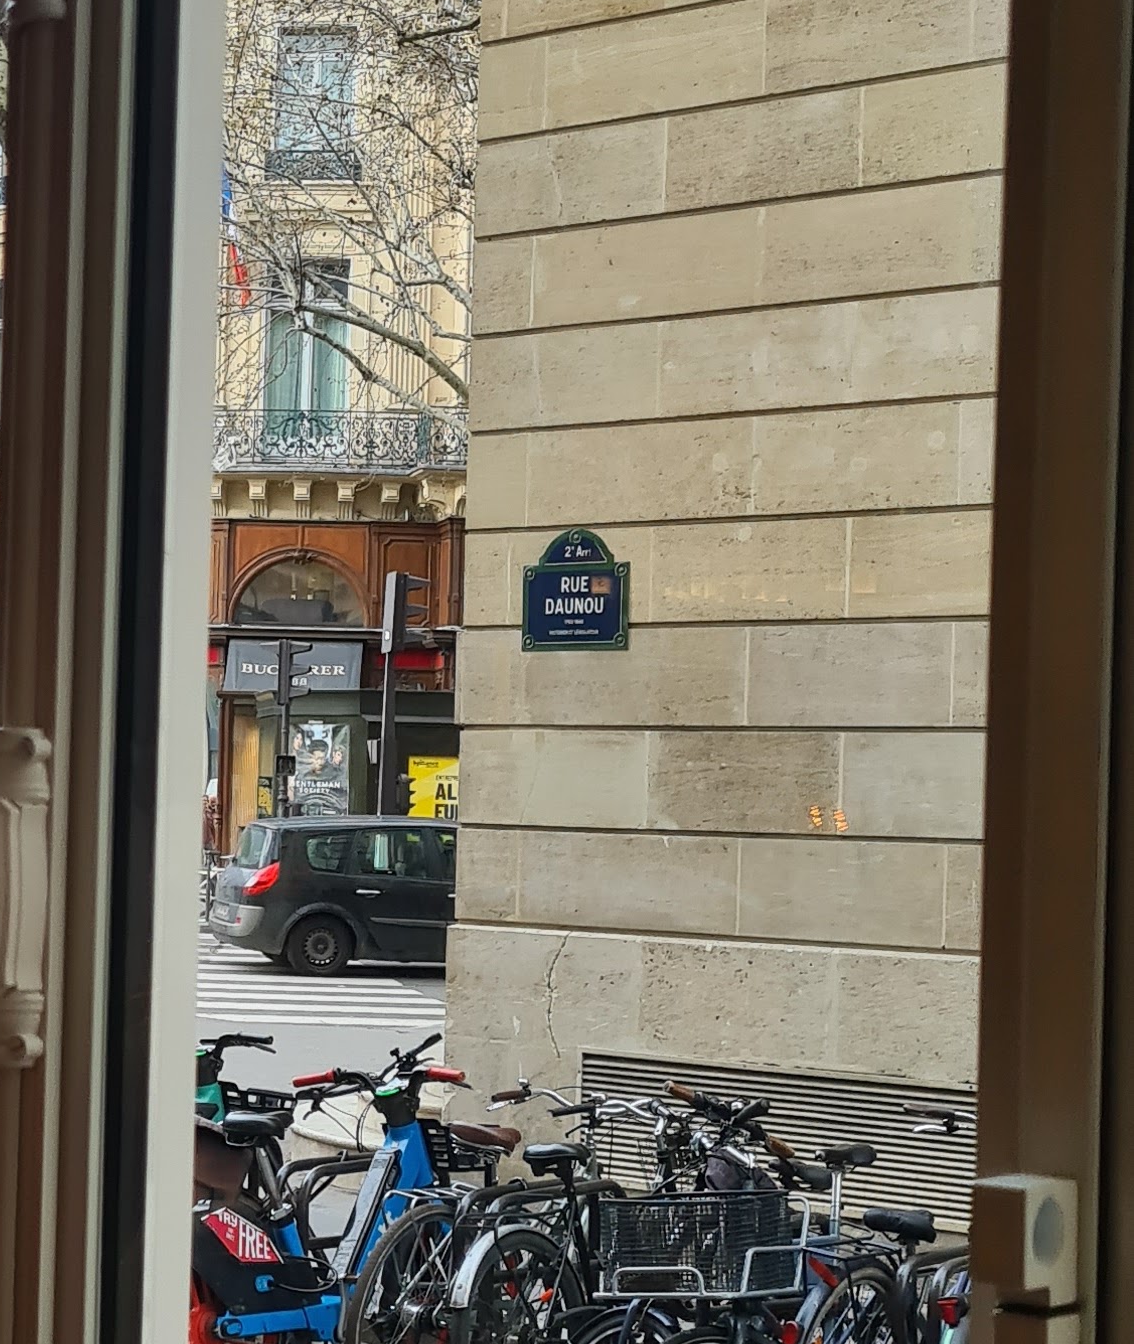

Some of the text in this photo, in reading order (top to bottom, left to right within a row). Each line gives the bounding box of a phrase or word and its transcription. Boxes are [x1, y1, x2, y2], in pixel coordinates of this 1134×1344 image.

[560, 576, 589, 593] RUE
[545, 597, 604, 615] DAUNOU
[241, 662, 346, 676] BUCRER
[238, 1219, 272, 1260] FREE
